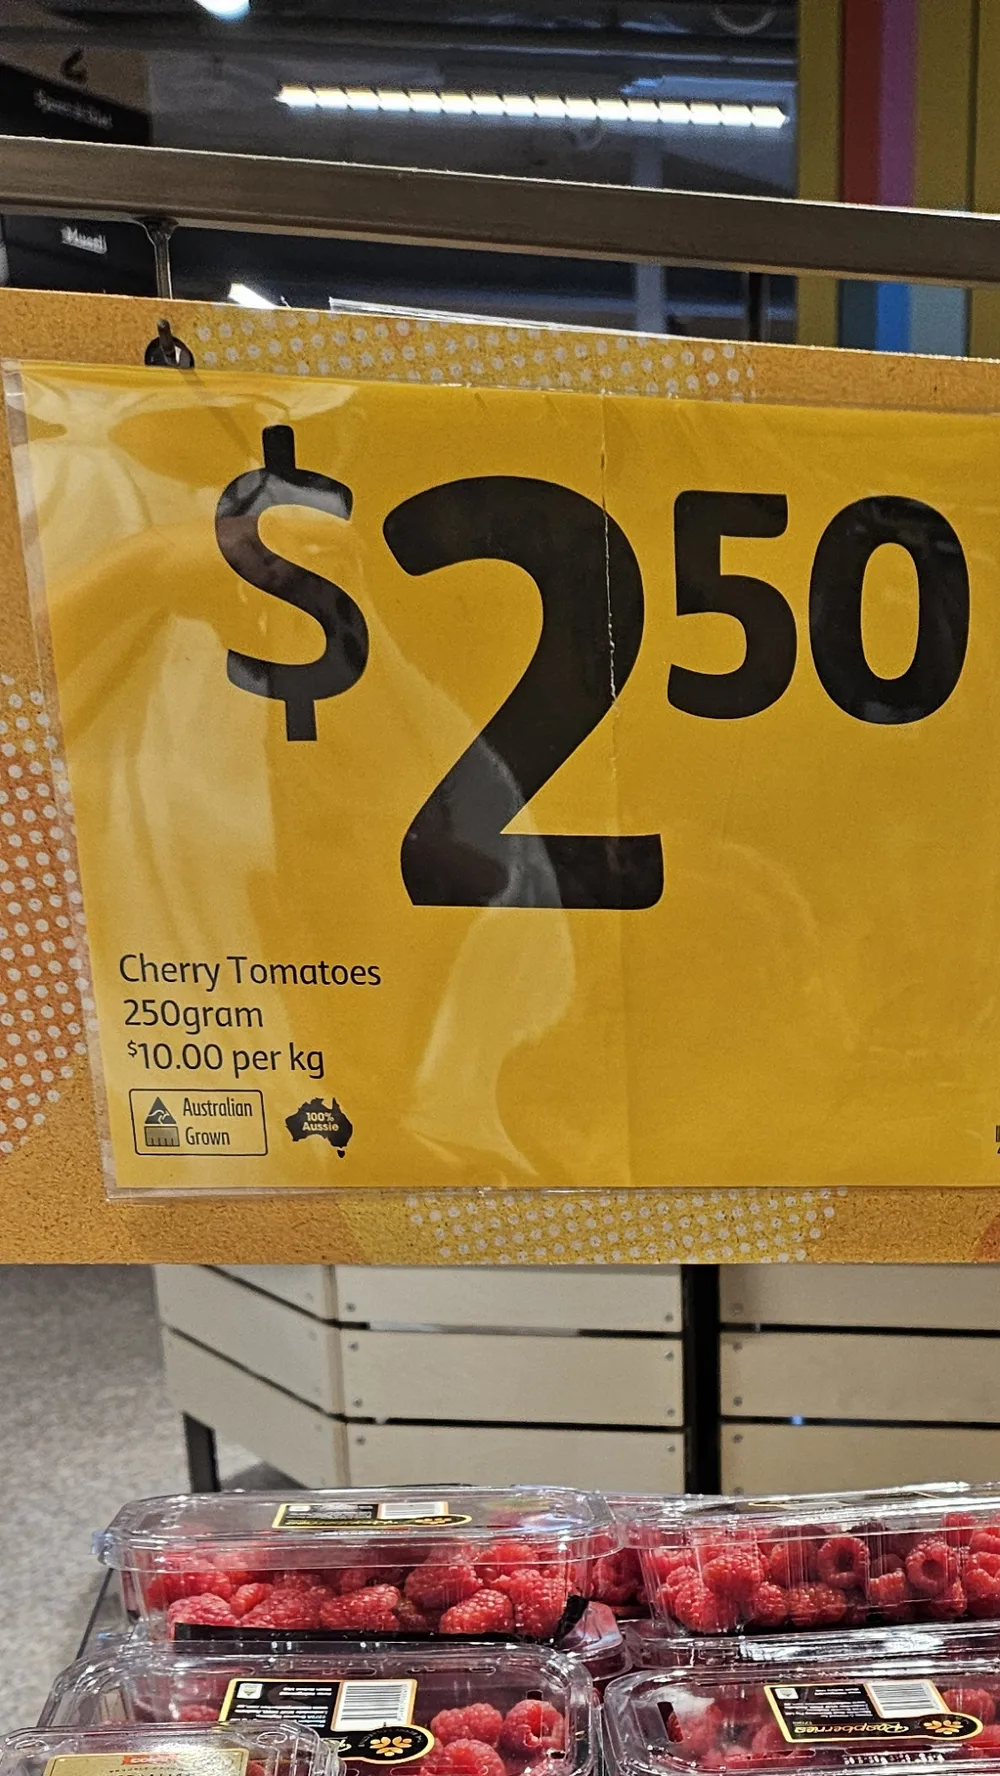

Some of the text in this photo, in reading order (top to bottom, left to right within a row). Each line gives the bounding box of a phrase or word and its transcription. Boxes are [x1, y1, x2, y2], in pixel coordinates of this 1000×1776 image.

[119, 953, 382, 992] Cherry Tomatoes
[123, 999, 264, 1035] 250gram
[127, 1040, 324, 1079] $10.00 per kg
[183, 1097, 252, 1117] Australian
[305, 1111, 335, 1123] 100%
[185, 1126, 230, 1146] Grown
[302, 1120, 339, 1132] Aussie
